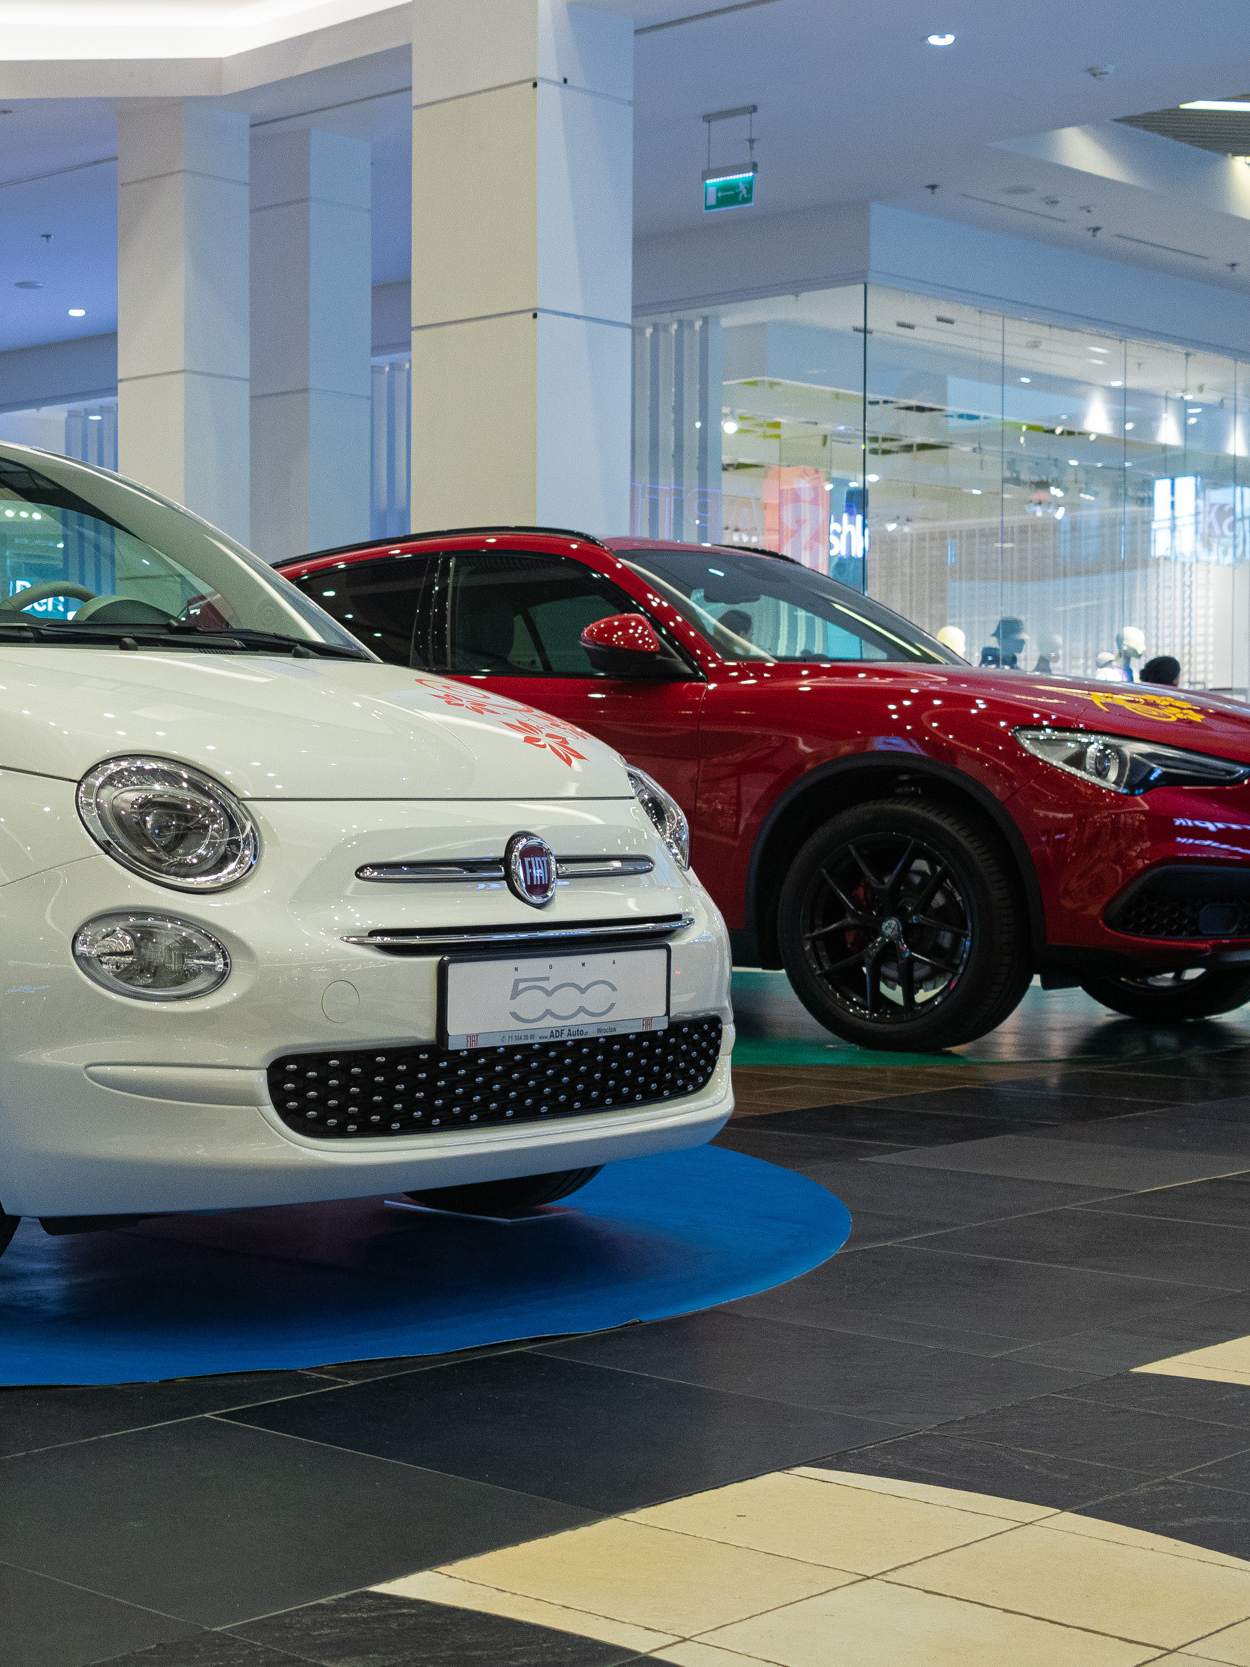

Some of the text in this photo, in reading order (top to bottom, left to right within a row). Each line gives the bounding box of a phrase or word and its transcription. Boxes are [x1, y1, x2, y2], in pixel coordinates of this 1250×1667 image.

[524, 856, 548, 886] FIAT
[509, 976, 617, 1023] 500
[466, 1034, 480, 1048] FIAT
